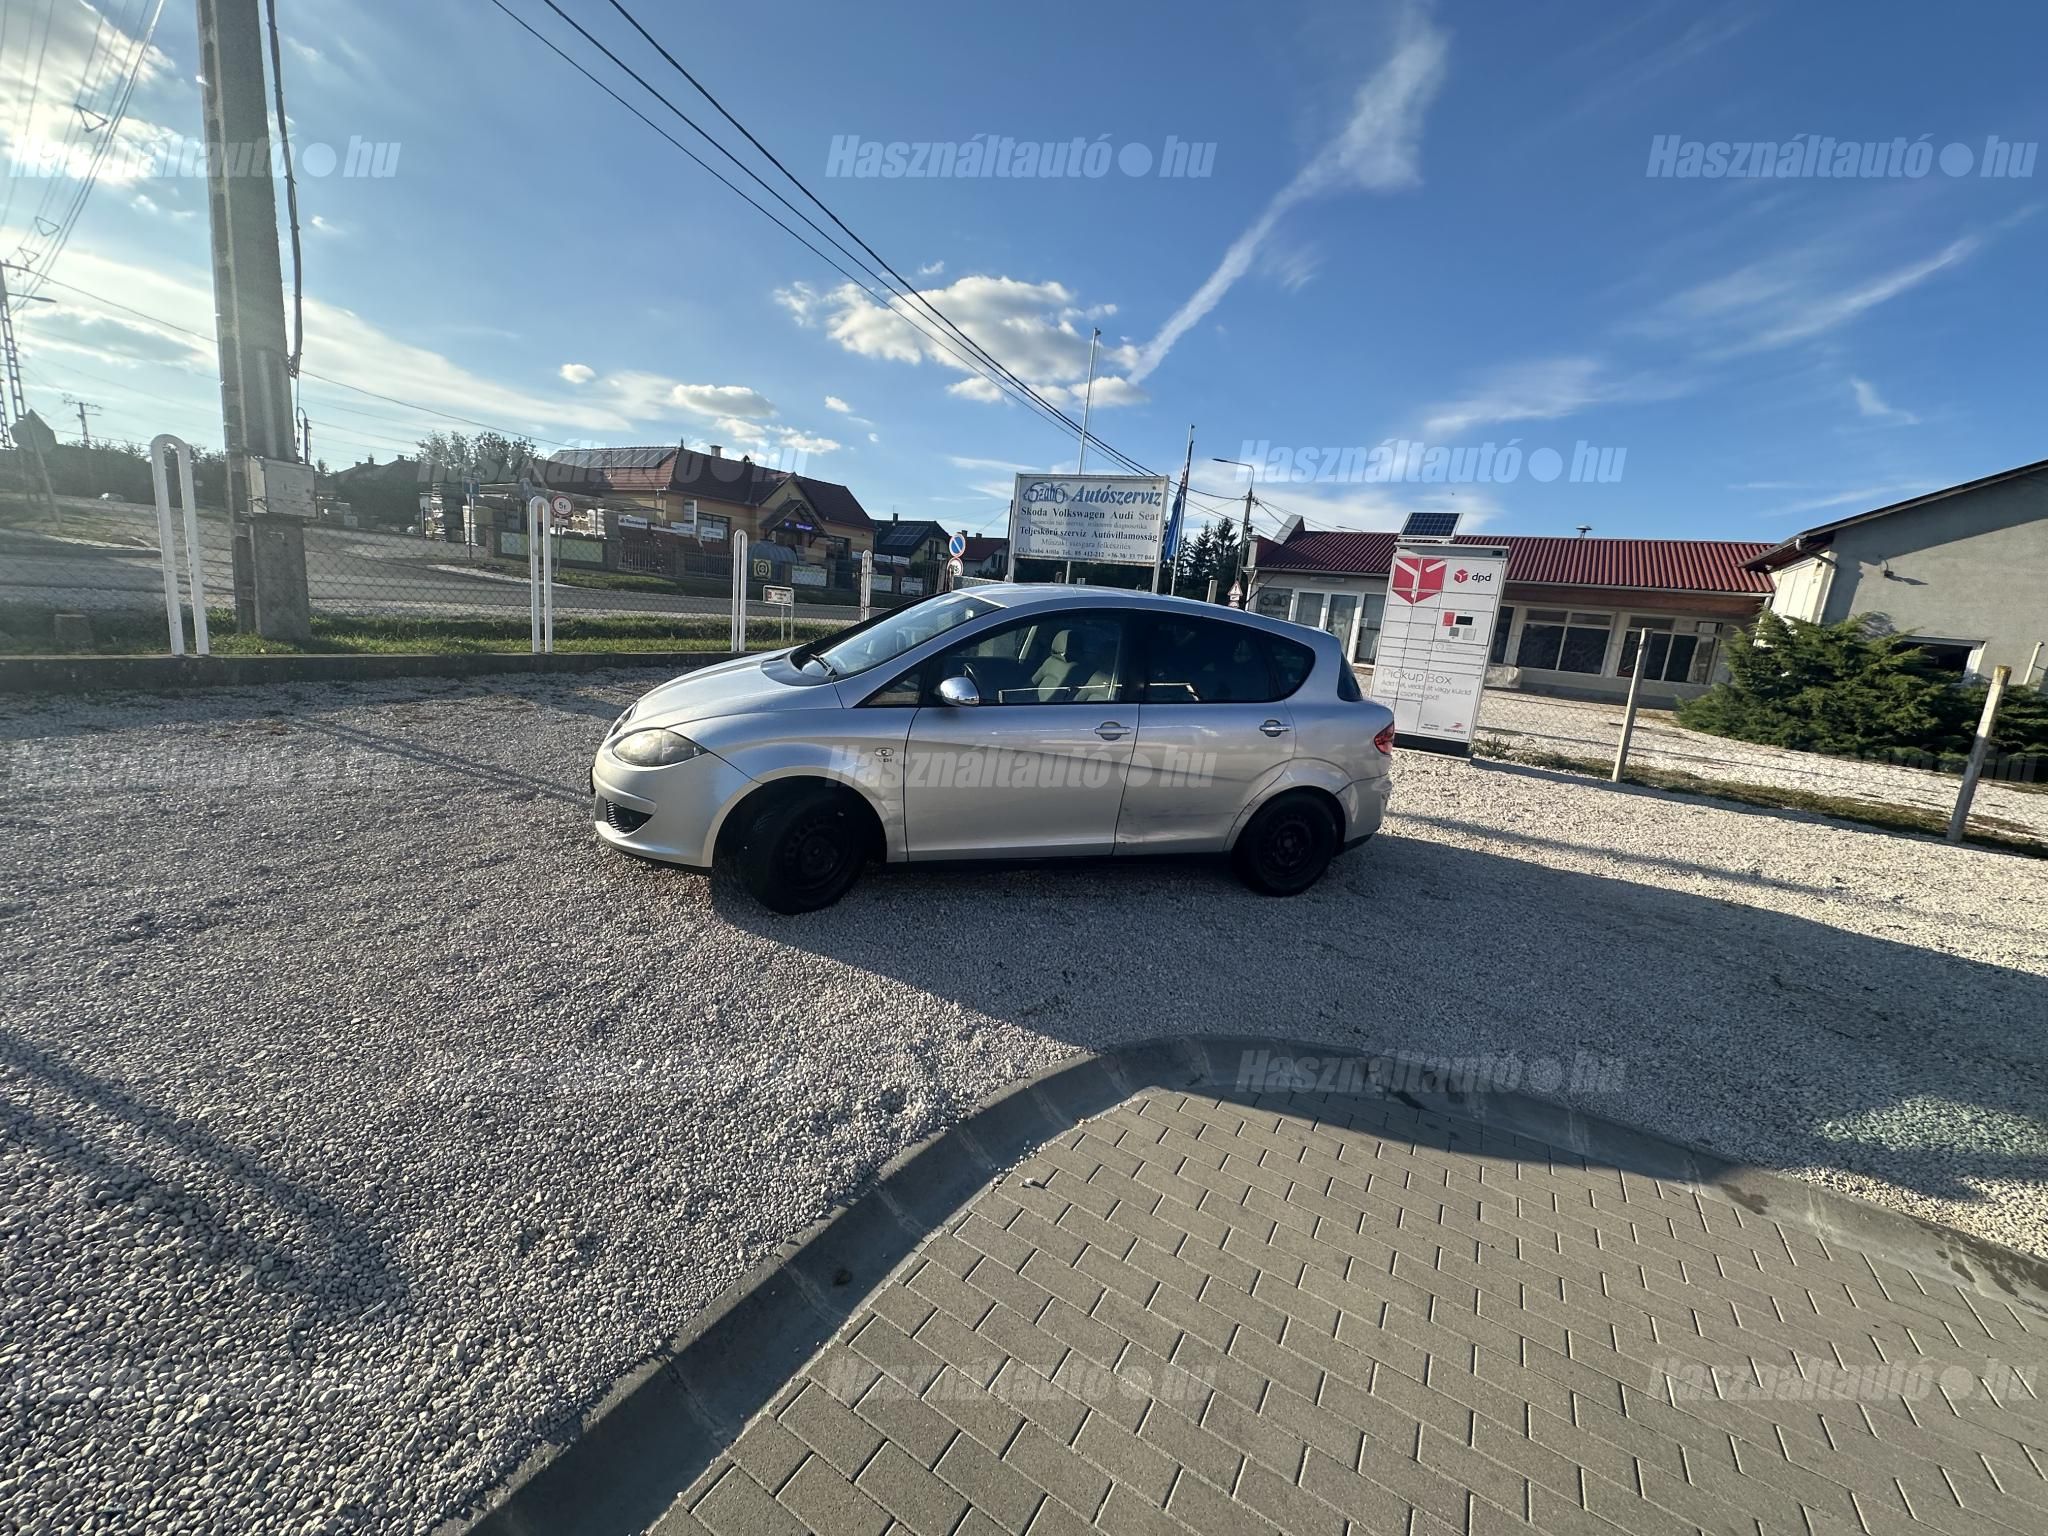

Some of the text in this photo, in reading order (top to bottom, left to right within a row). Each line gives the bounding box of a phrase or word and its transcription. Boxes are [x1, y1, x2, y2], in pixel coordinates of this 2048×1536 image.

[1071, 485, 1161, 507] Autószerviz
[1021, 507, 1160, 521] Skoda Volkswagen Audi Seat
[1060, 528, 1087, 538] szerviz
[1091, 530, 1158, 542] Autóvillamosság
[1472, 572, 1492, 583] dpd
[1383, 668, 1453, 685] Pickup Box
